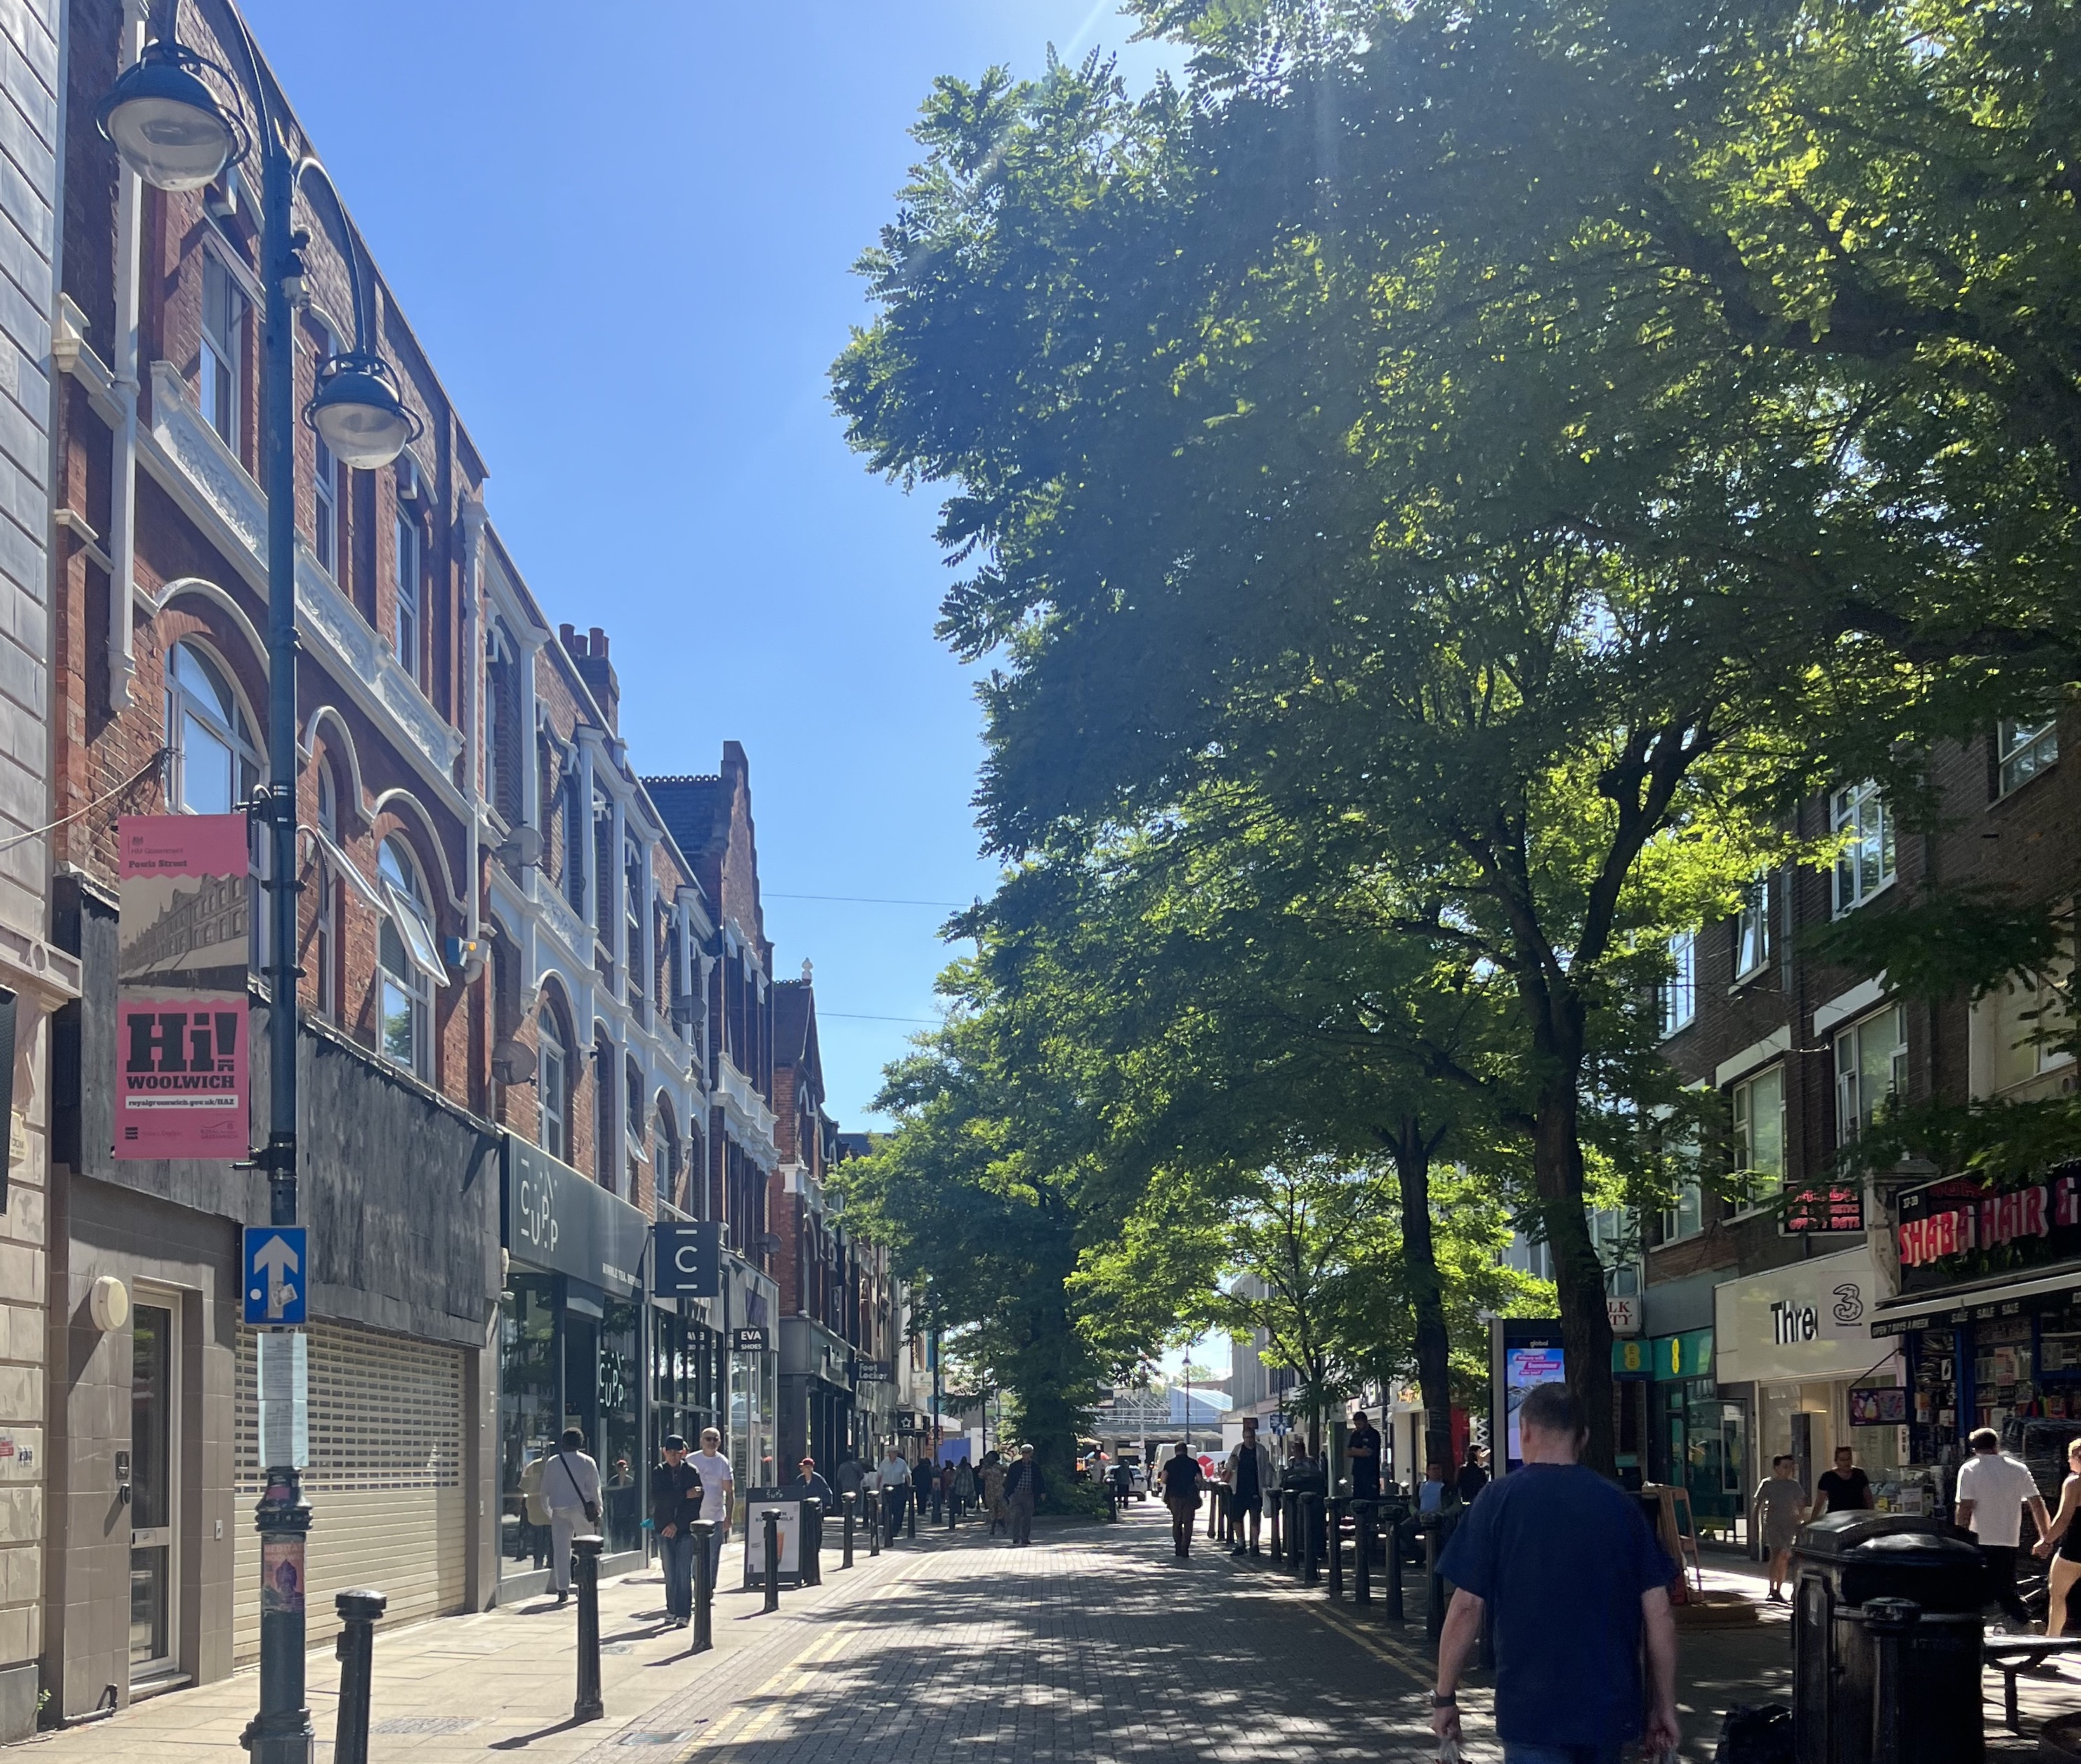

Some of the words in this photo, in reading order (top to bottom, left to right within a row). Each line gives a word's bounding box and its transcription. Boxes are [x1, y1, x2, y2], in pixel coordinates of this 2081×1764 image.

[126, 1013, 237, 1072] Hi!
[126, 1075, 235, 1089] WOOLWICH
[1831, 1216, 1860, 1229] DAYS
[1981, 1186, 2049, 1251] HAIR
[675, 1246, 697, 1273] C
[1976, 1307, 1995, 1319] SALE
[1771, 1301, 1819, 1345] Thre
[740, 1331, 762, 1341] EVA
[859, 1363, 878, 1371] Foot
